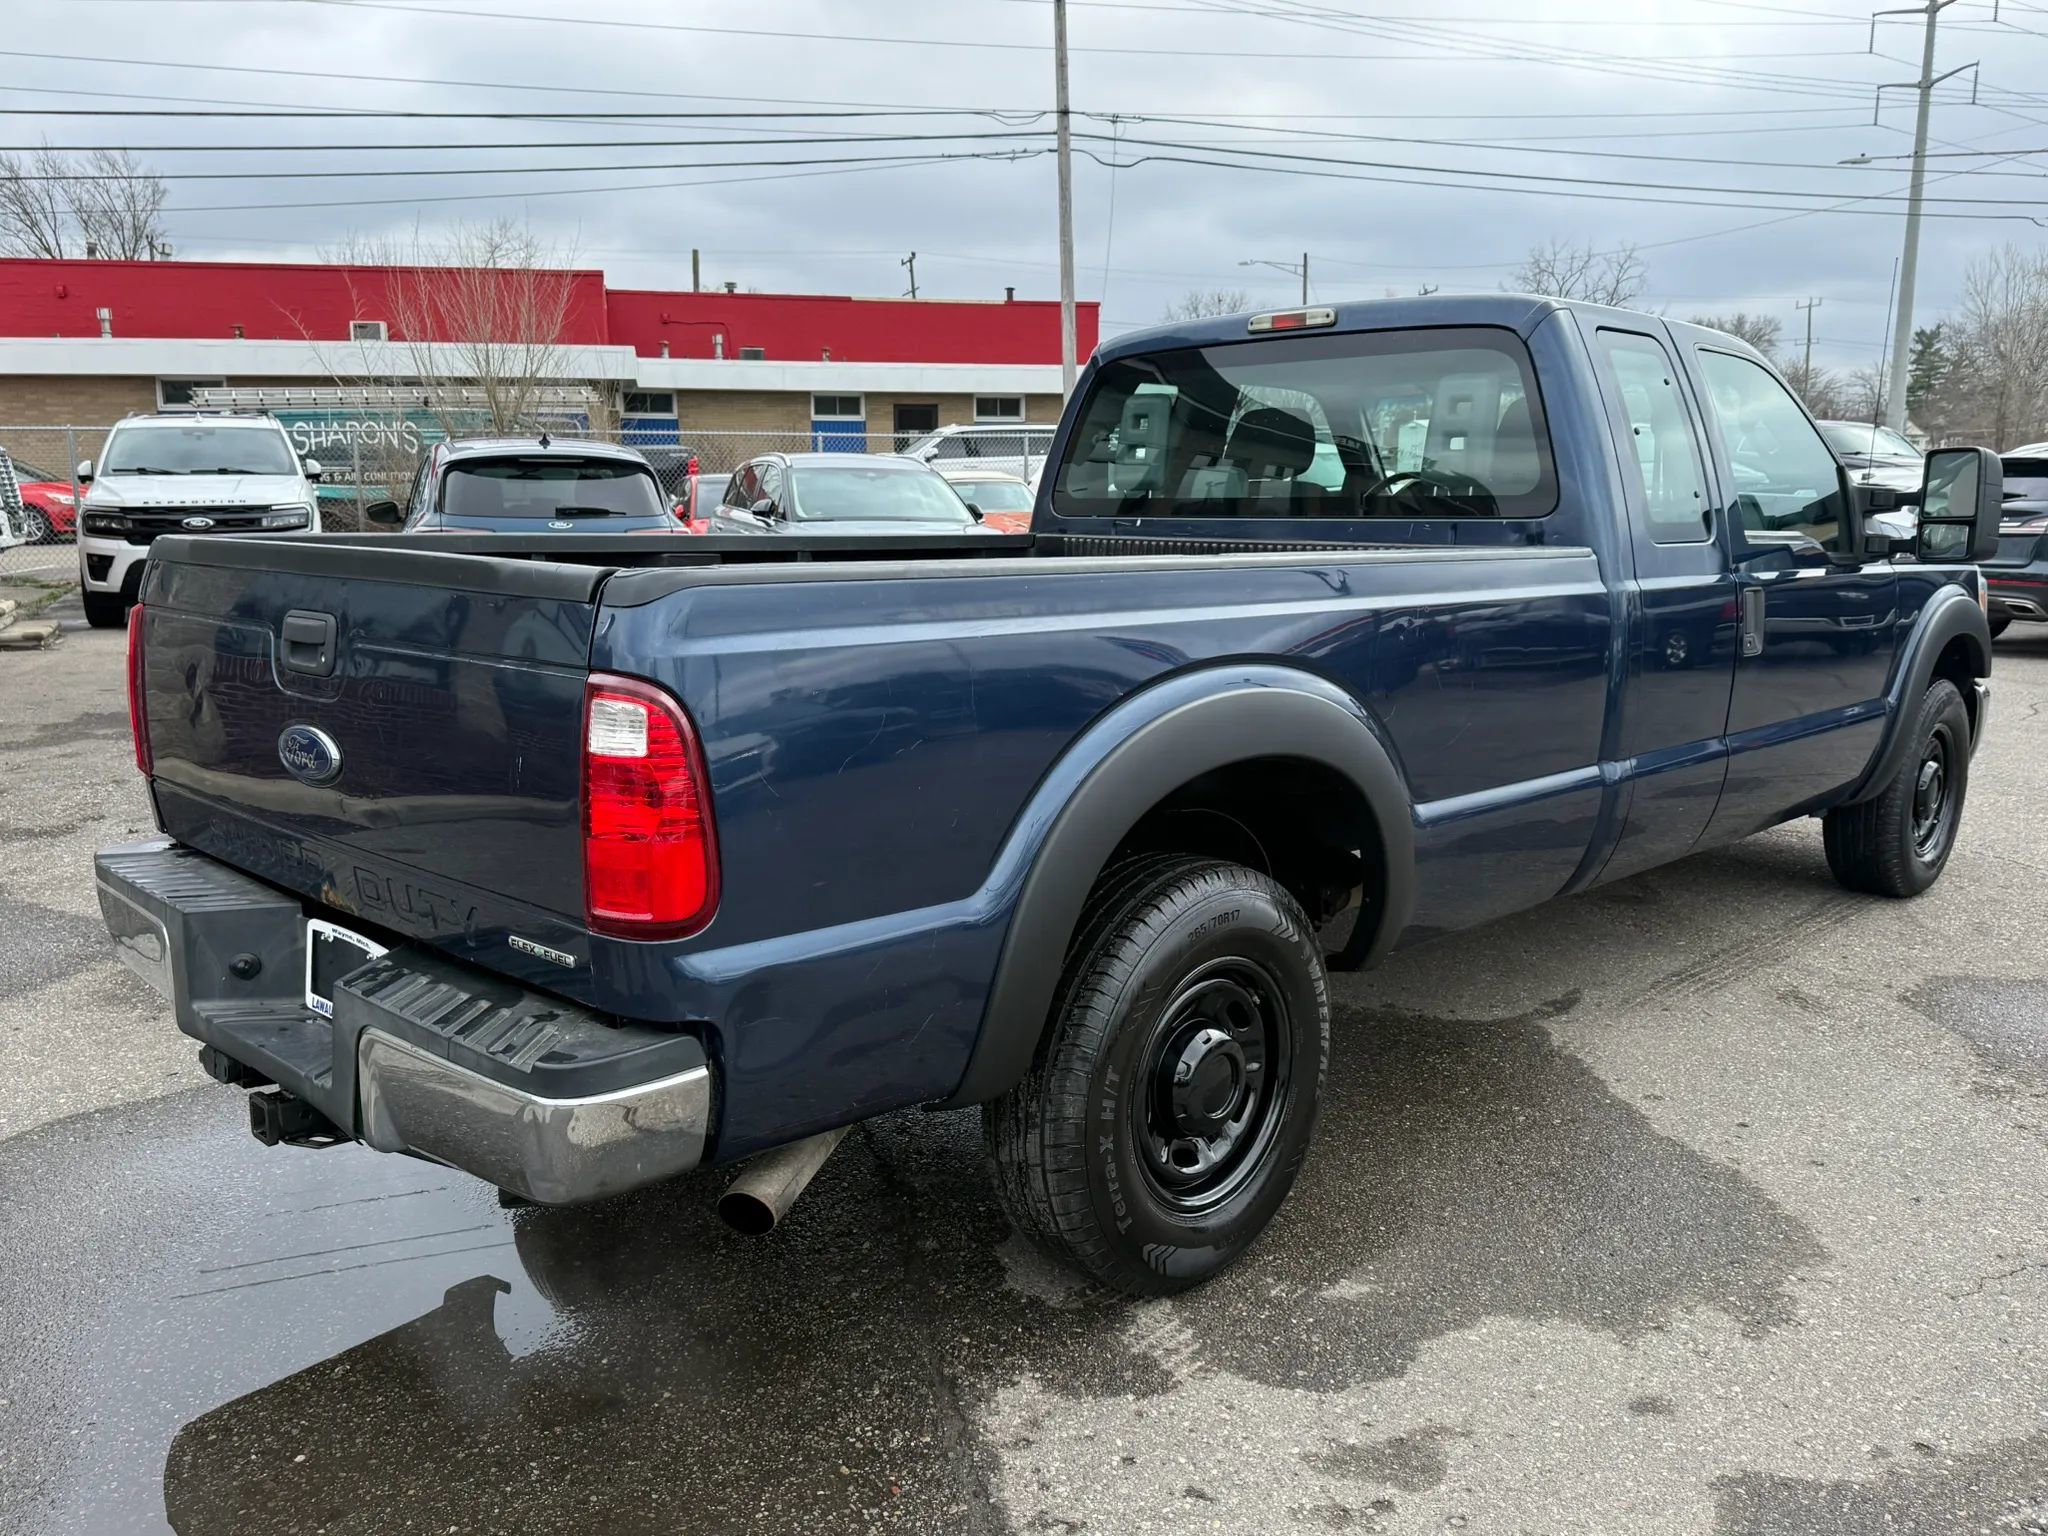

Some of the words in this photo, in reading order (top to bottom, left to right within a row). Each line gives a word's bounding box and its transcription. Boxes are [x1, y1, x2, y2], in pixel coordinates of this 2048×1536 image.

[293, 421, 418, 455] SHARON'S
[285, 734, 319, 769] Ford
[353, 865, 479, 946] DUTY
[1187, 909, 1241, 943] 265/70R17
[511, 938, 536, 955] FLEX
[543, 950, 572, 967] FUEL
[1100, 1064, 1121, 1120] H/T
